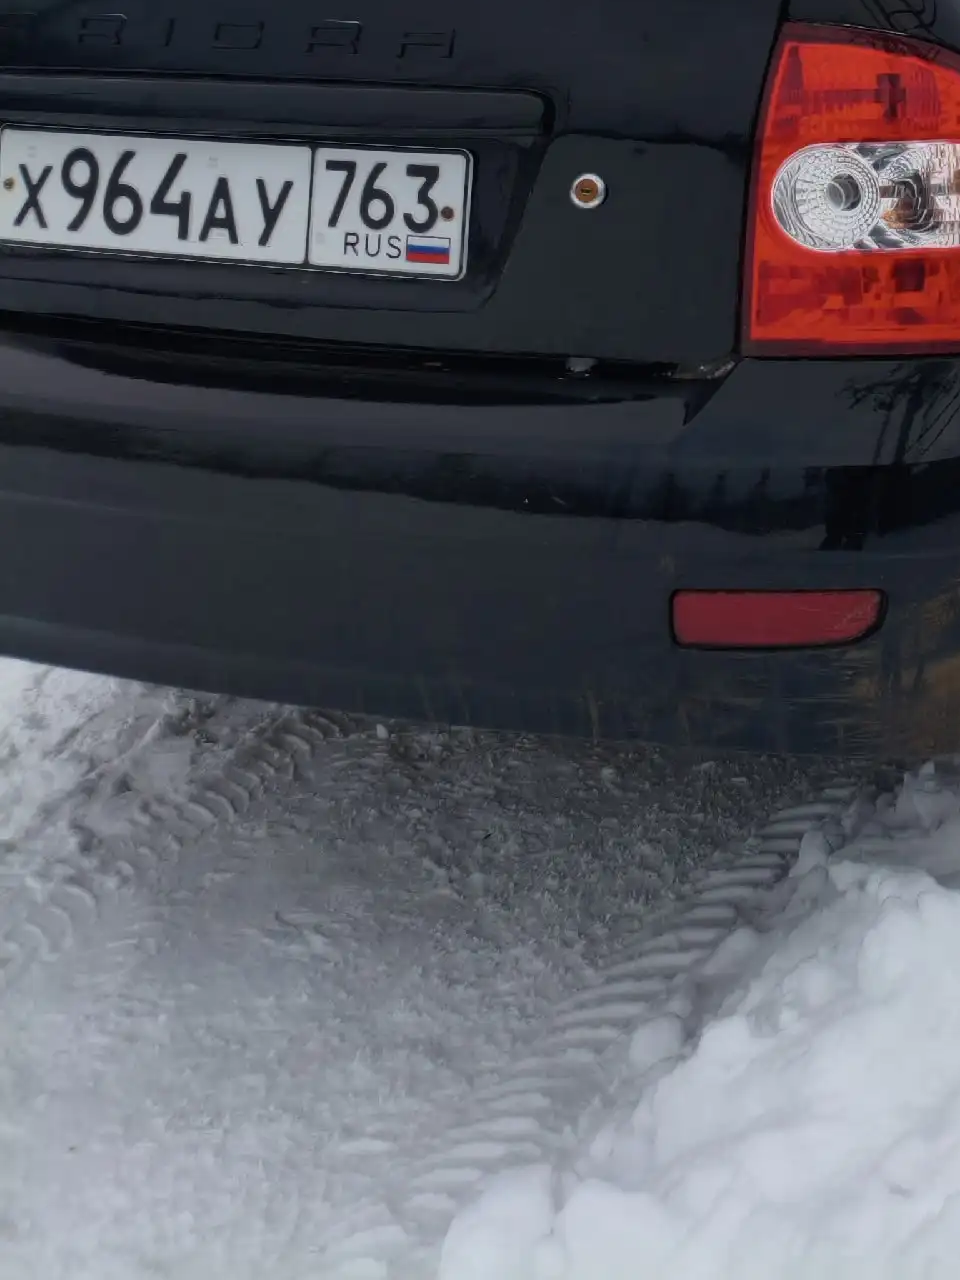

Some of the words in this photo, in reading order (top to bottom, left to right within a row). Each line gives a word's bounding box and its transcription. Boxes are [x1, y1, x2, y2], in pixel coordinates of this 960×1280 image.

[13, 147, 294, 246] Х964АУ
[325, 160, 440, 234] 763
[343, 232, 402, 259] RUS
